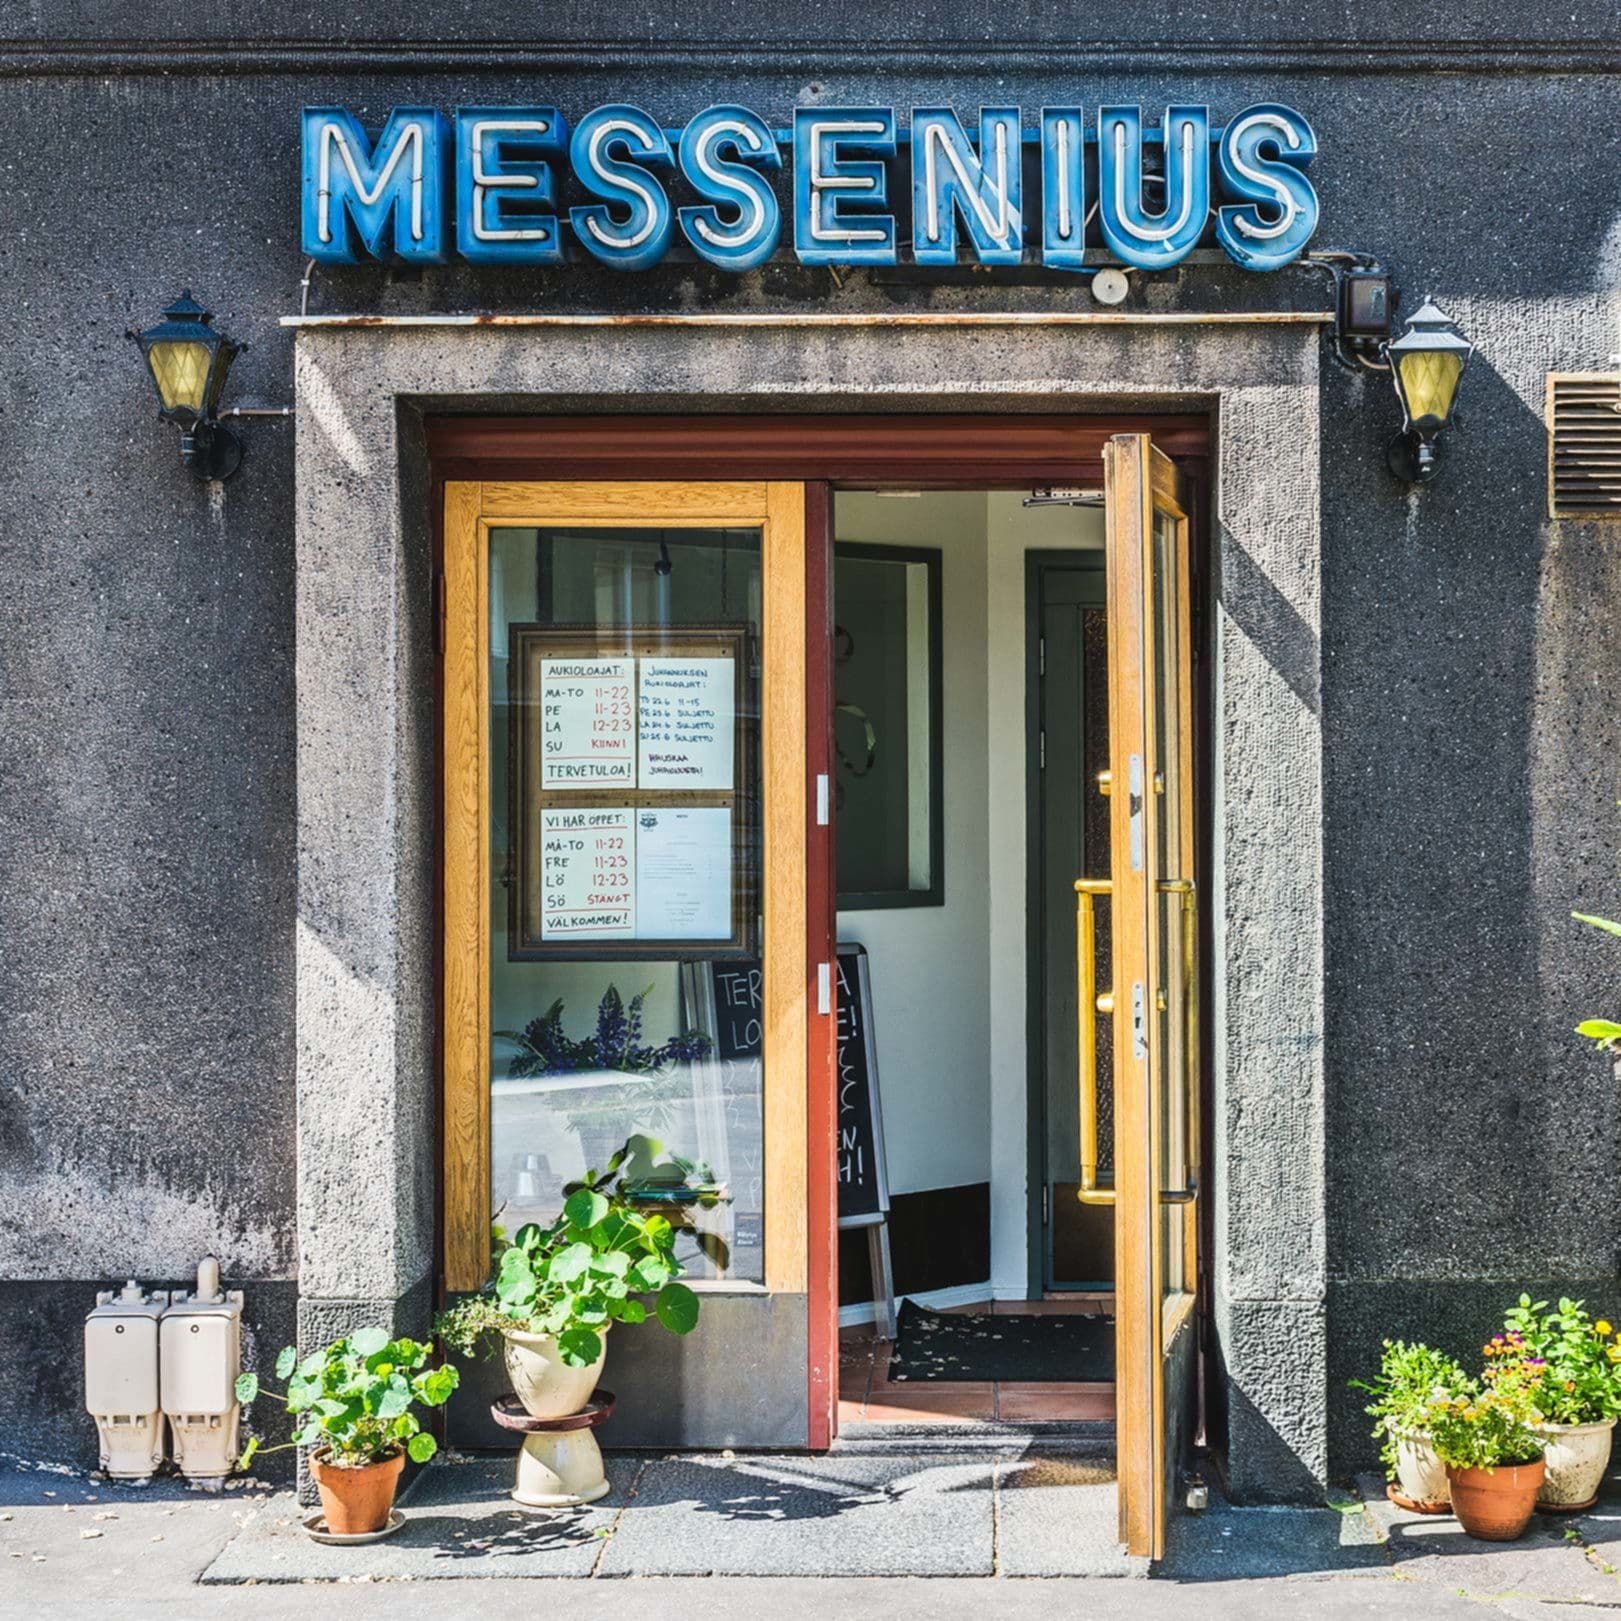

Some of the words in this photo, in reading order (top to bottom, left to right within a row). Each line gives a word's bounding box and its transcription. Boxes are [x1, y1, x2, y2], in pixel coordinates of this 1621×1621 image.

[299, 102, 1320, 272] MESSENIUS
[545, 688, 584, 699] MA-TO
[595, 686, 629, 700] 11-22
[545, 705, 562, 717] PE
[595, 702, 632, 716] 11-23
[545, 721, 561, 733] LA
[592, 719, 632, 732] 12-23
[545, 740, 563, 753] SU
[547, 762, 632, 778] TERVETULOA!
[546, 816, 560, 827] VI
[563, 814, 586, 828] HAR
[545, 857, 570, 870] FRE
[546, 873, 565, 888] LÖ
[546, 894, 566, 909] SÖ
